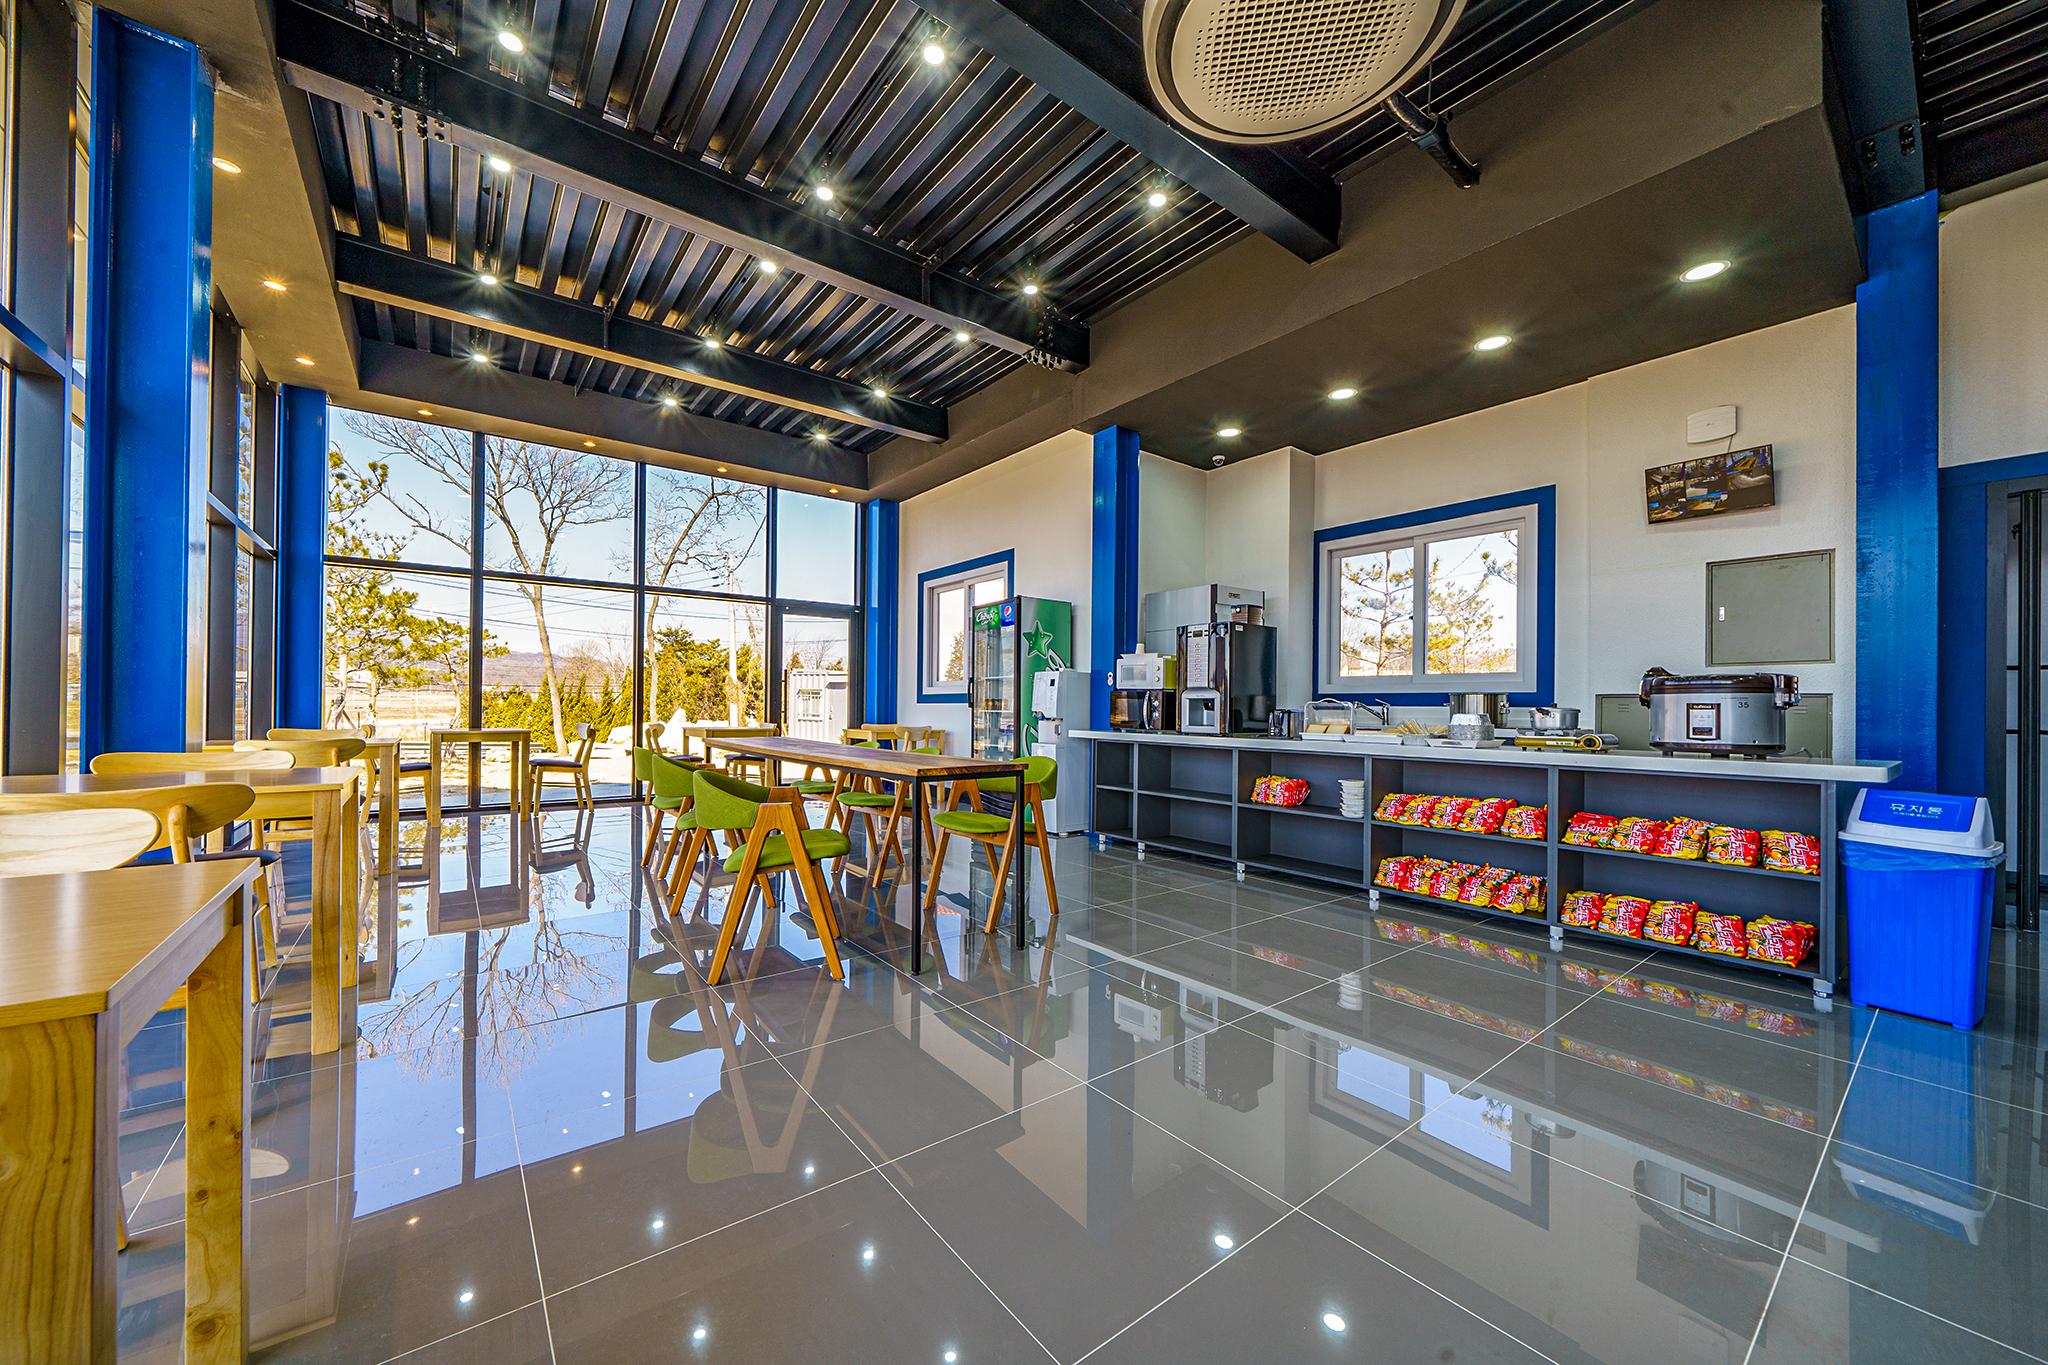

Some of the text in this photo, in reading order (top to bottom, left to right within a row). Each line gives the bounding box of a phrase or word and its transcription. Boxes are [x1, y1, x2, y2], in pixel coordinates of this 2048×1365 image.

[1737, 701, 1750, 709] 35
[1786, 834, 1808, 866] 진라면
[1711, 918, 1734, 949] 진라면
[1761, 923, 1785, 957] 진라면
